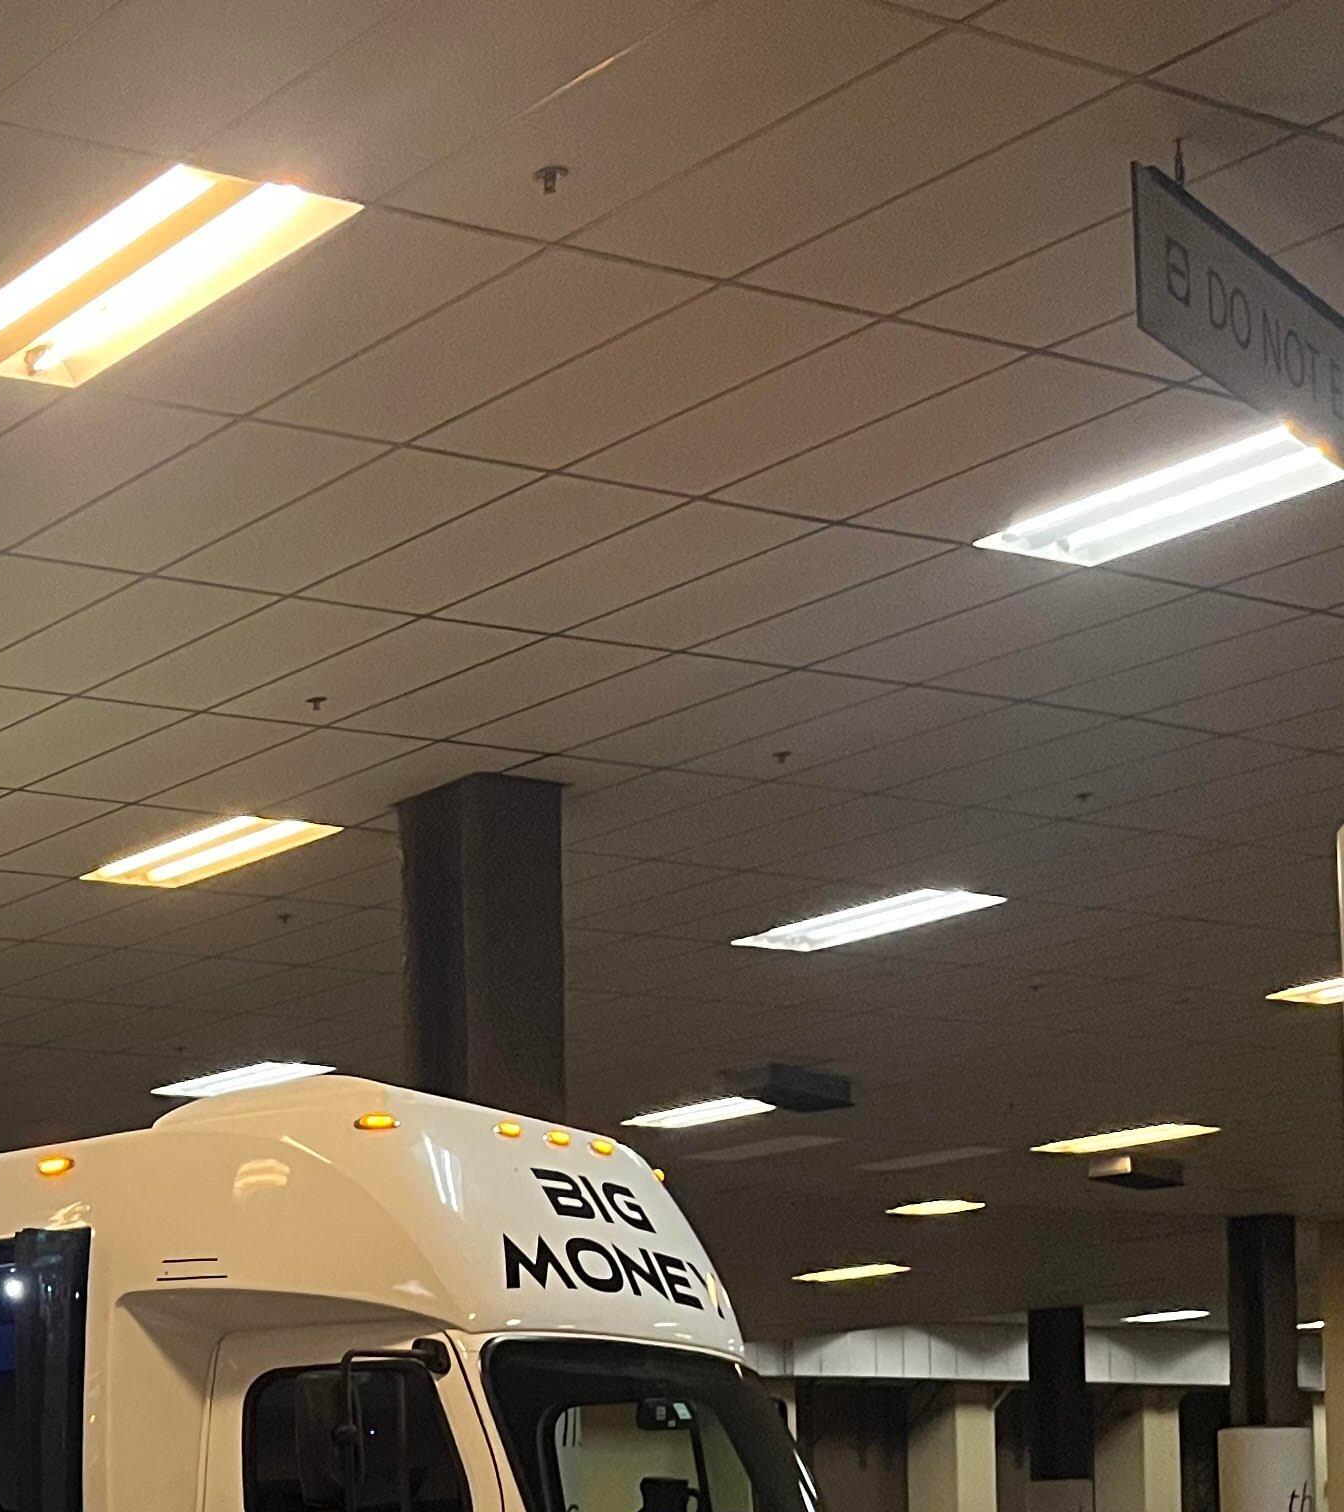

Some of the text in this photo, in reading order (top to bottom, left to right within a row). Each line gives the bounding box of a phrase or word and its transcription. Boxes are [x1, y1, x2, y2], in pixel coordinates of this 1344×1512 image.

[1207, 266, 1252, 350] DO
[1262, 310, 1320, 401] NOT
[530, 1167, 657, 1233] BIG
